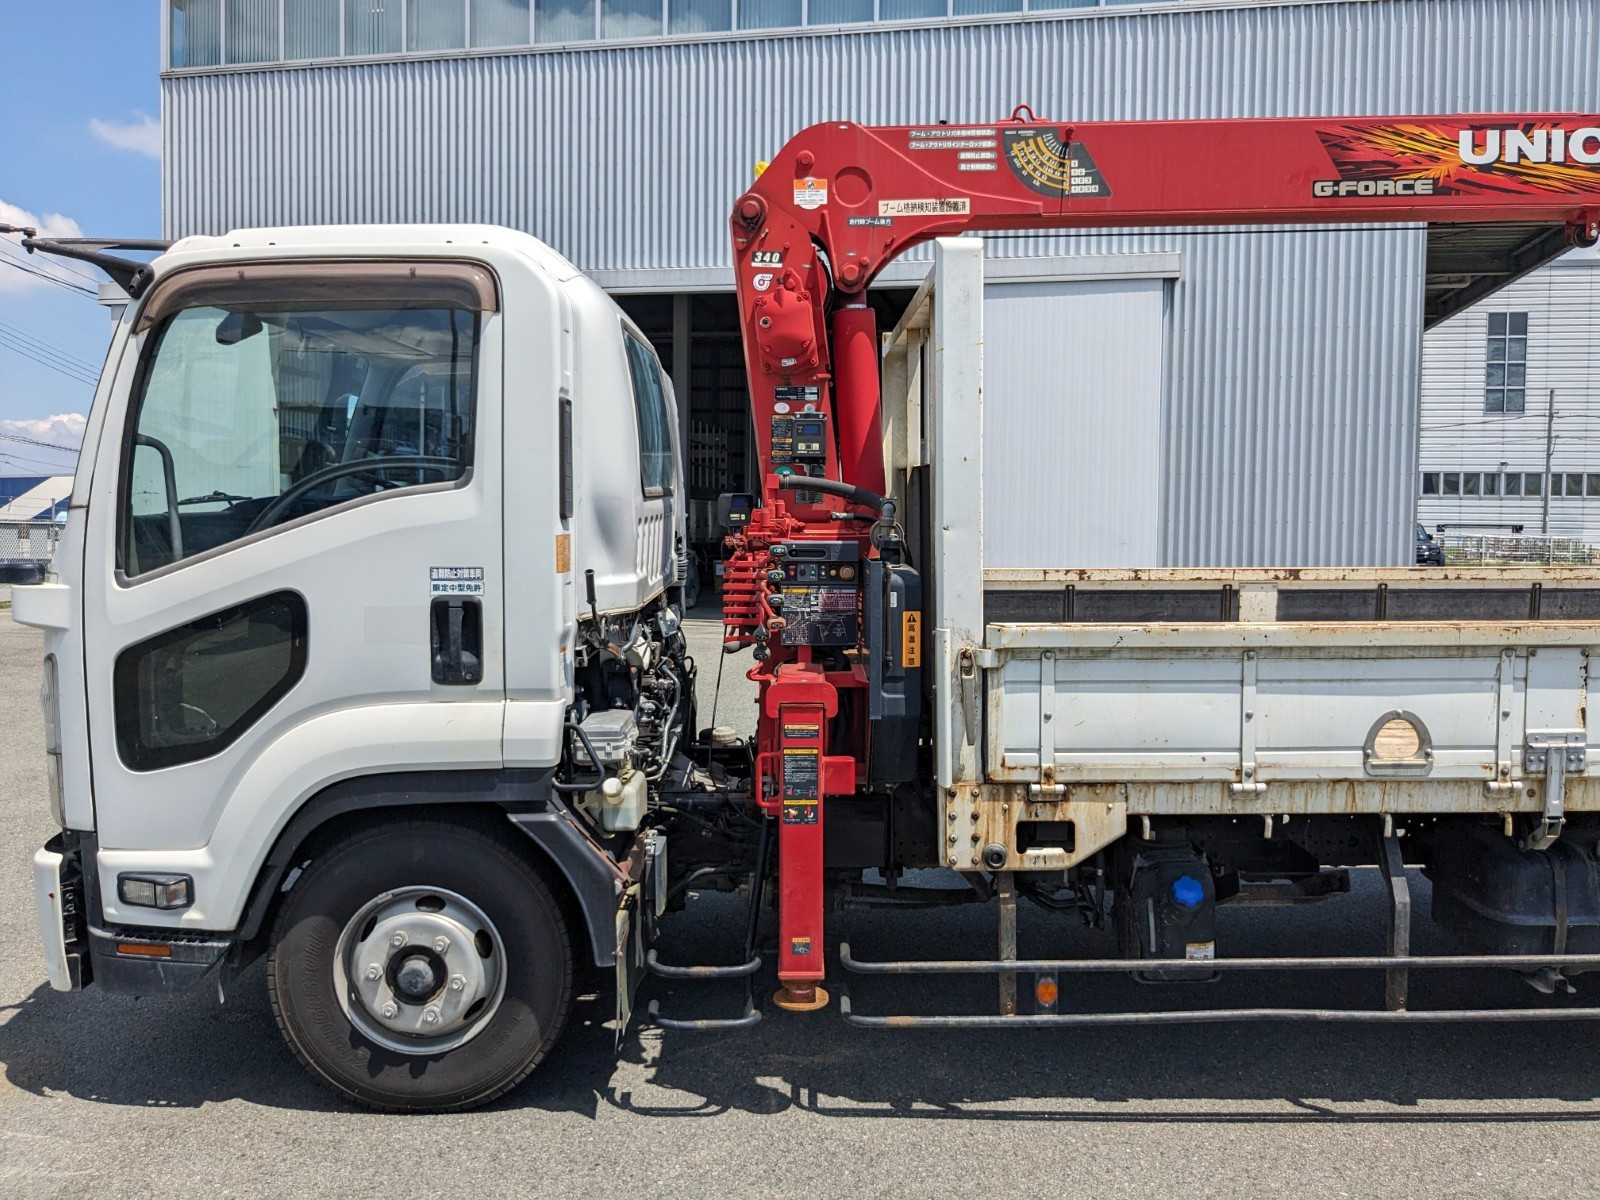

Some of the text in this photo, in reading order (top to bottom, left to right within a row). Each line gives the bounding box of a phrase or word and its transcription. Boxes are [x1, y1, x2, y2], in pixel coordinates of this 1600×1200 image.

[754, 252, 780, 263] 340
[432, 583, 482, 592] 限定中型免許
[907, 623, 916, 665] 高温注意
